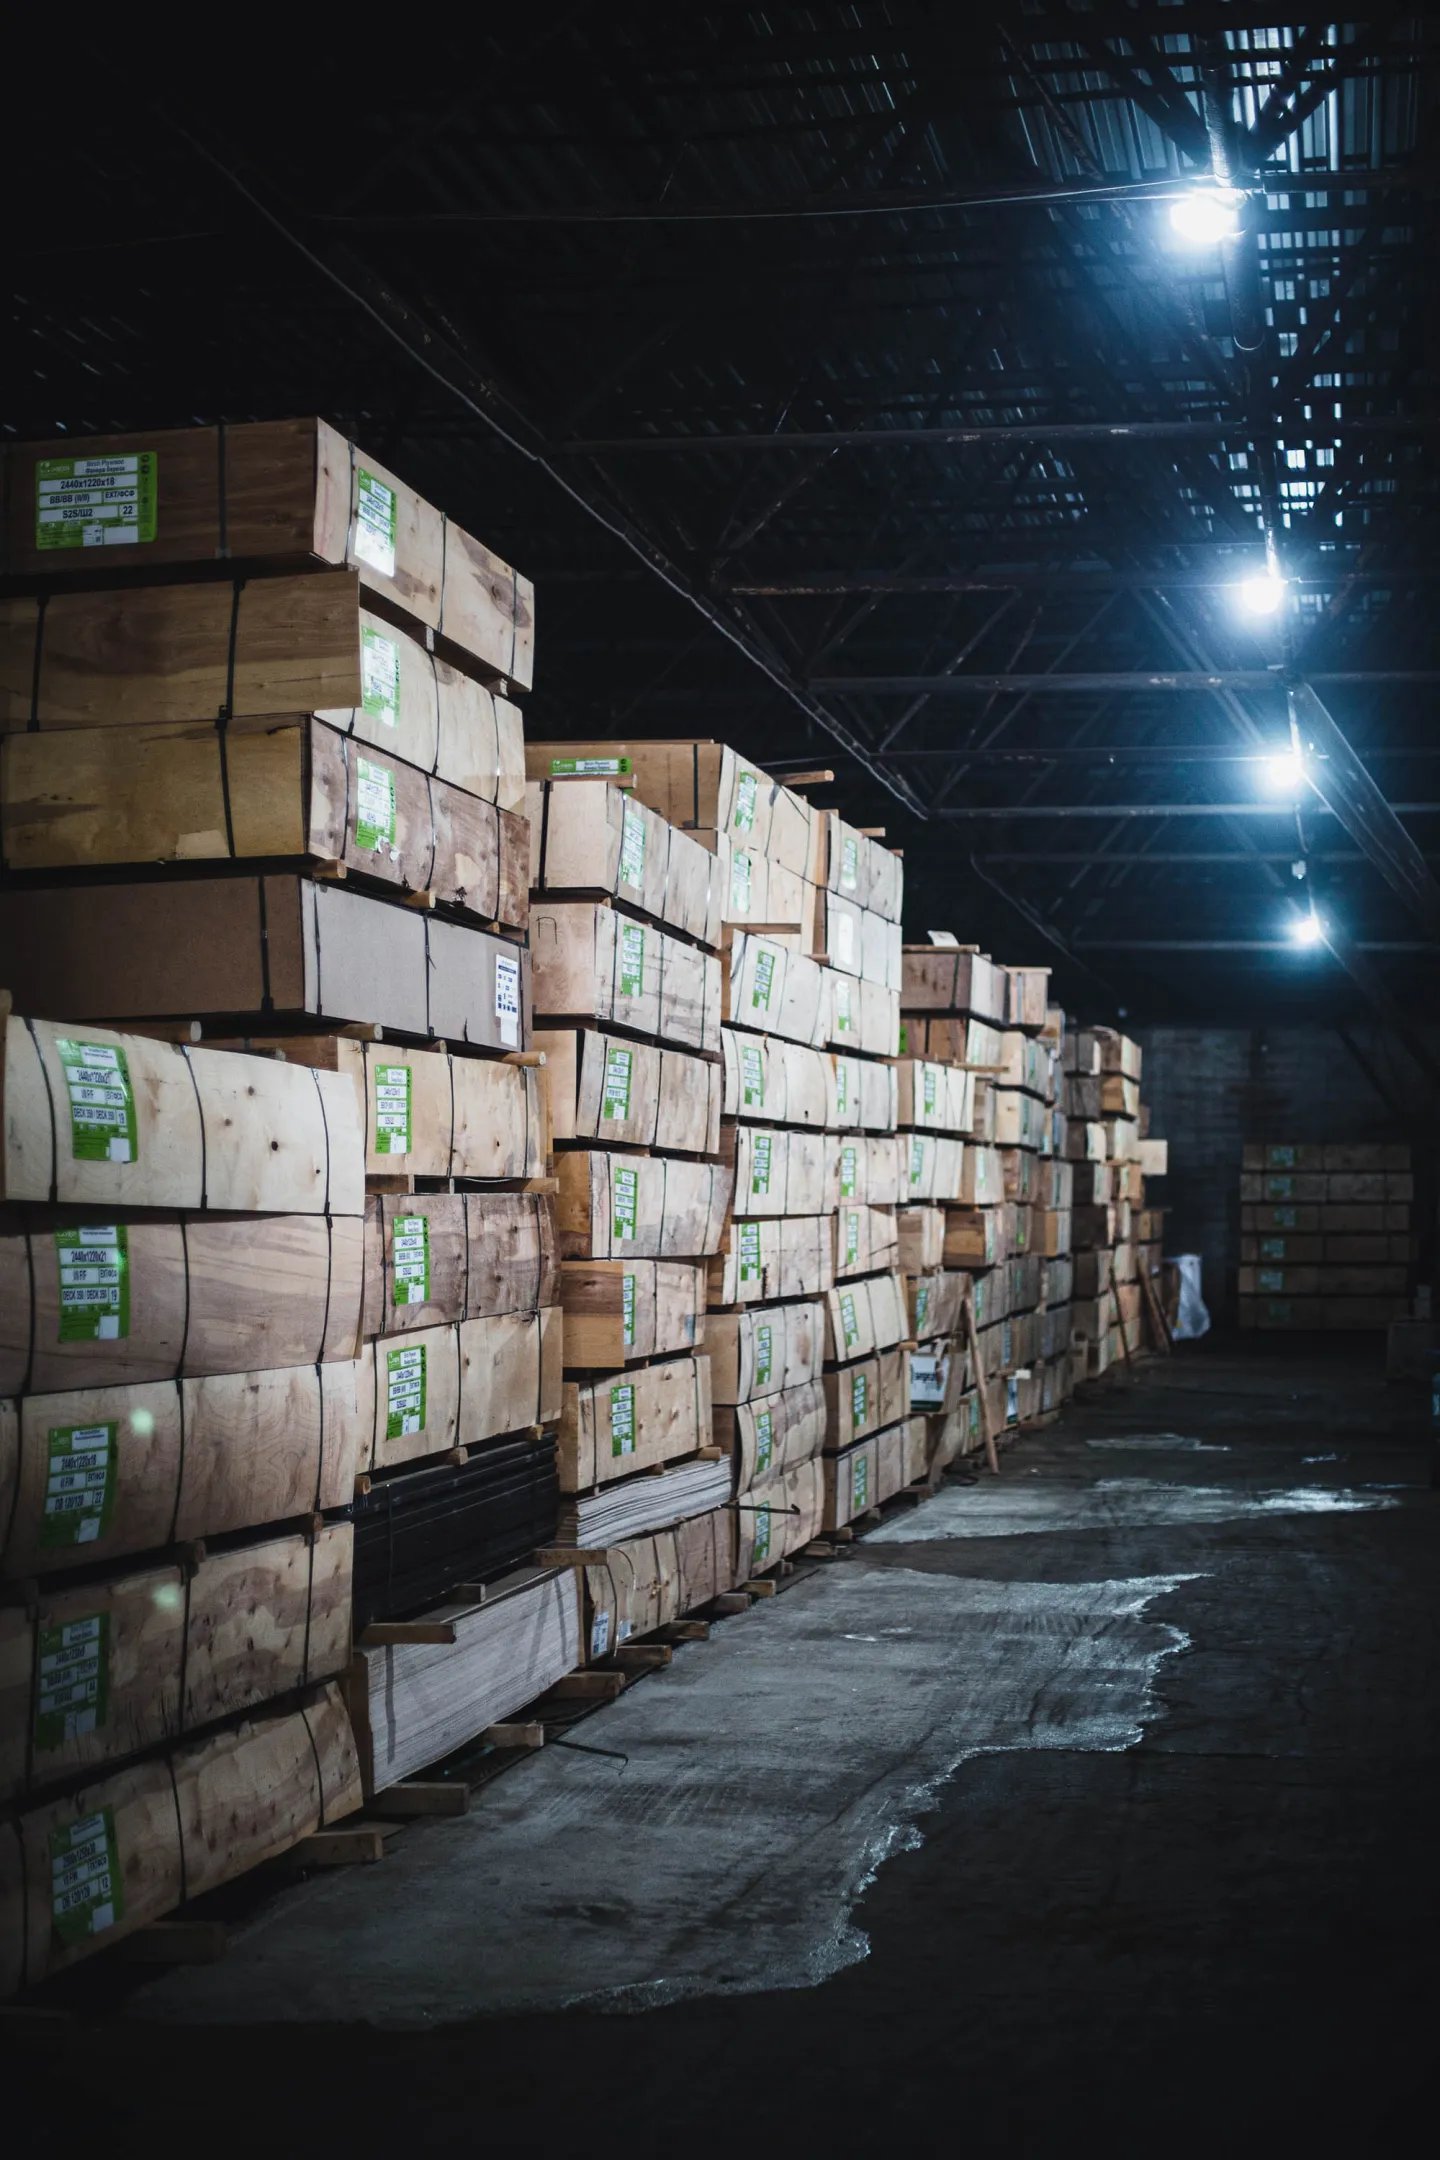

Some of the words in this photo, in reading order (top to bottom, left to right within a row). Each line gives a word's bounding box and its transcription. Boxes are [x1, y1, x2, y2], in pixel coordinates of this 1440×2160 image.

[61, 477, 115, 489] 2440x1220x18
[105, 490, 134, 498] EXT/ФСФ
[50, 495, 73, 504] BB/BB
[63, 509, 92, 518] S2S/Ш2
[123, 506, 132, 514] 22
[111, 1289, 117, 1301] 19
[95, 1492, 102, 1504] 22
